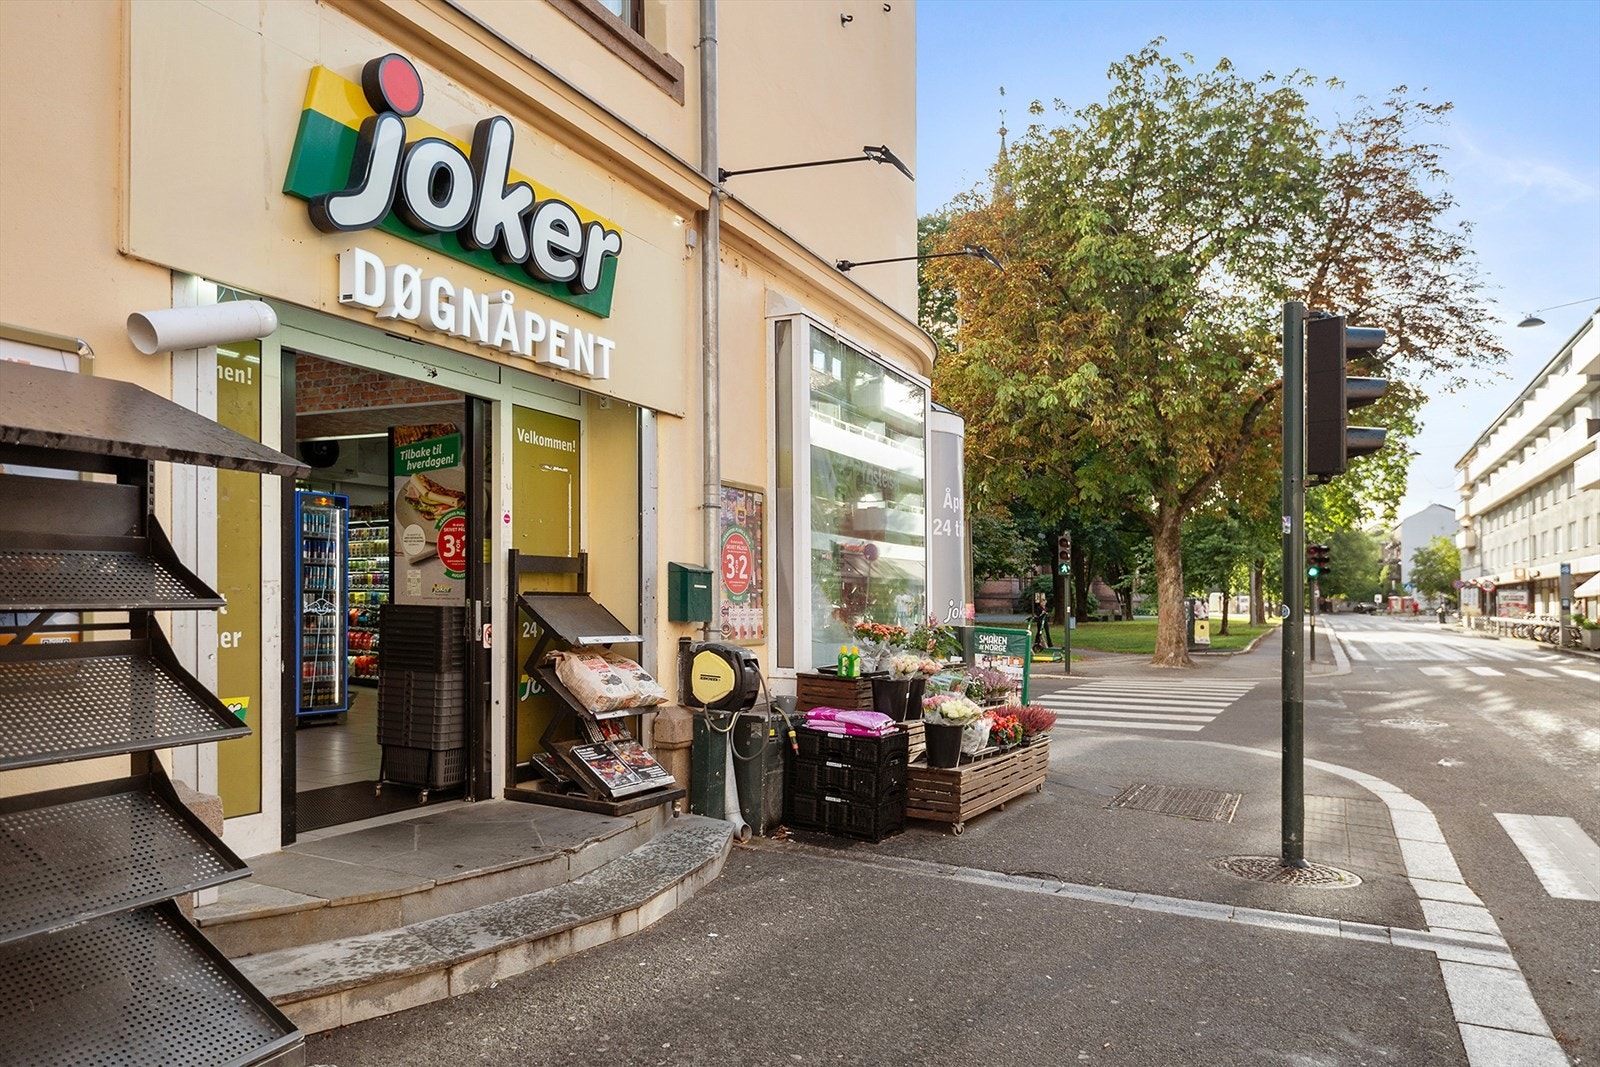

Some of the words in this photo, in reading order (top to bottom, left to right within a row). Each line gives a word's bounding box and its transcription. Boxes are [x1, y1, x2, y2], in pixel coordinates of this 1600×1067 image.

[312, 54, 622, 294] joker
[345, 247, 617, 380] DØGNÅPENT
[517, 427, 576, 453] Velkommen!
[400, 446, 431, 461] Tilbake
[432, 443, 442, 455] til
[406, 453, 454, 470] hverdagen!
[933, 518, 951, 537] 24
[443, 534, 456, 558] 3
[726, 553, 735, 579] 3
[738, 554, 748, 579] 2
[522, 621, 538, 638] 24
[978, 634, 1008, 646] SMAKEN
[984, 643, 1007, 653] NORGE
